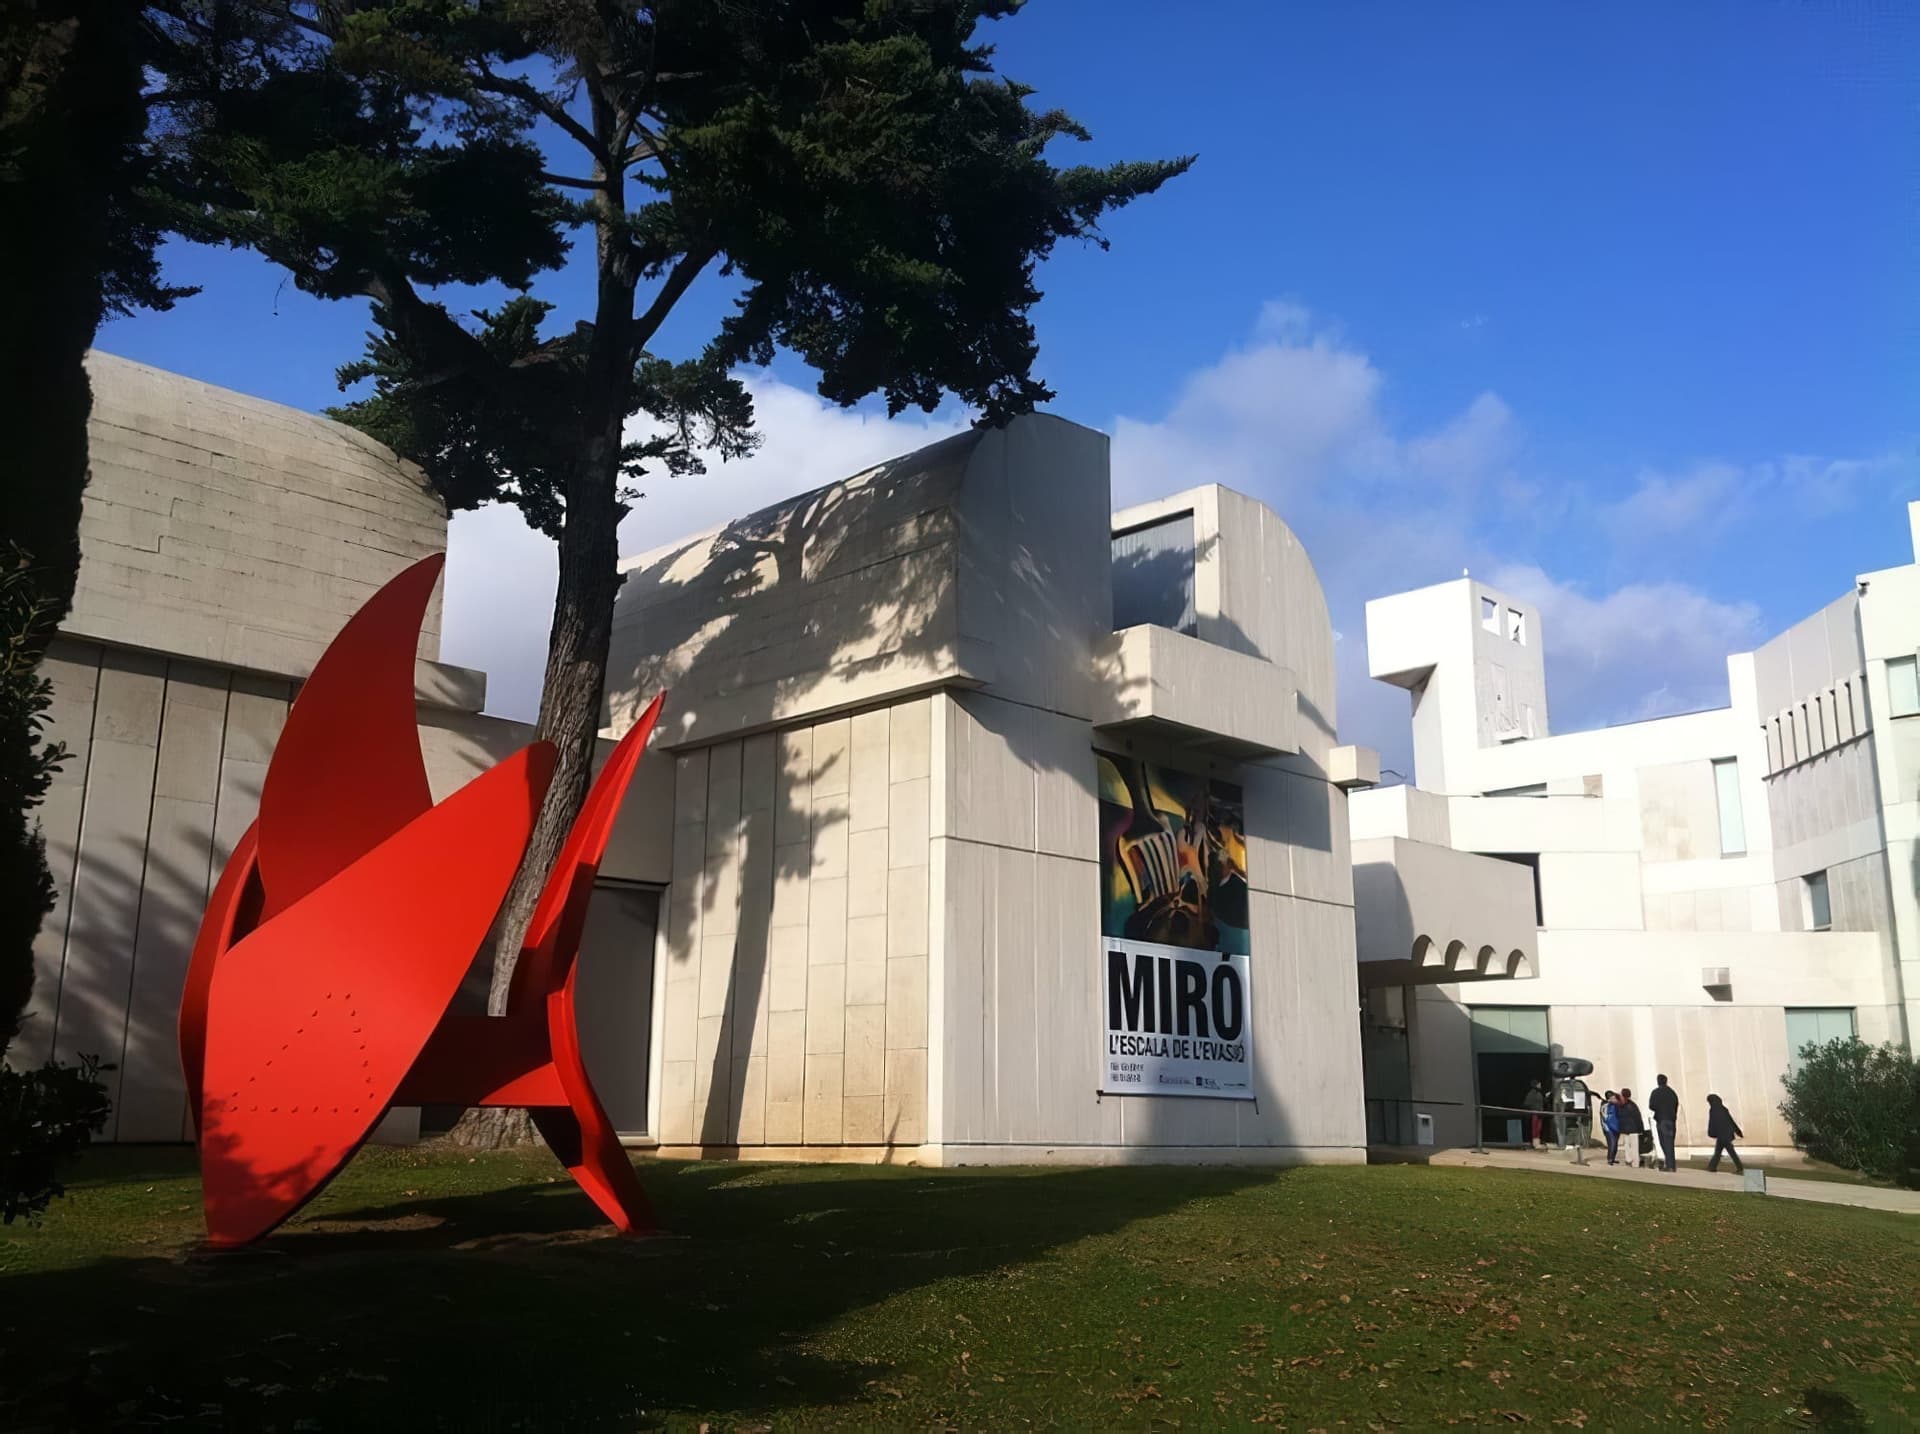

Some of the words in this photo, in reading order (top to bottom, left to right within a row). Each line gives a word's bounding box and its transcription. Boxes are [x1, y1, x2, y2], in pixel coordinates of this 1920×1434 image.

[1108, 951, 1242, 1041] MIRÓ
[1109, 1034, 1169, 1058] L'ESCALA
[1173, 1039, 1189, 1059] DE
